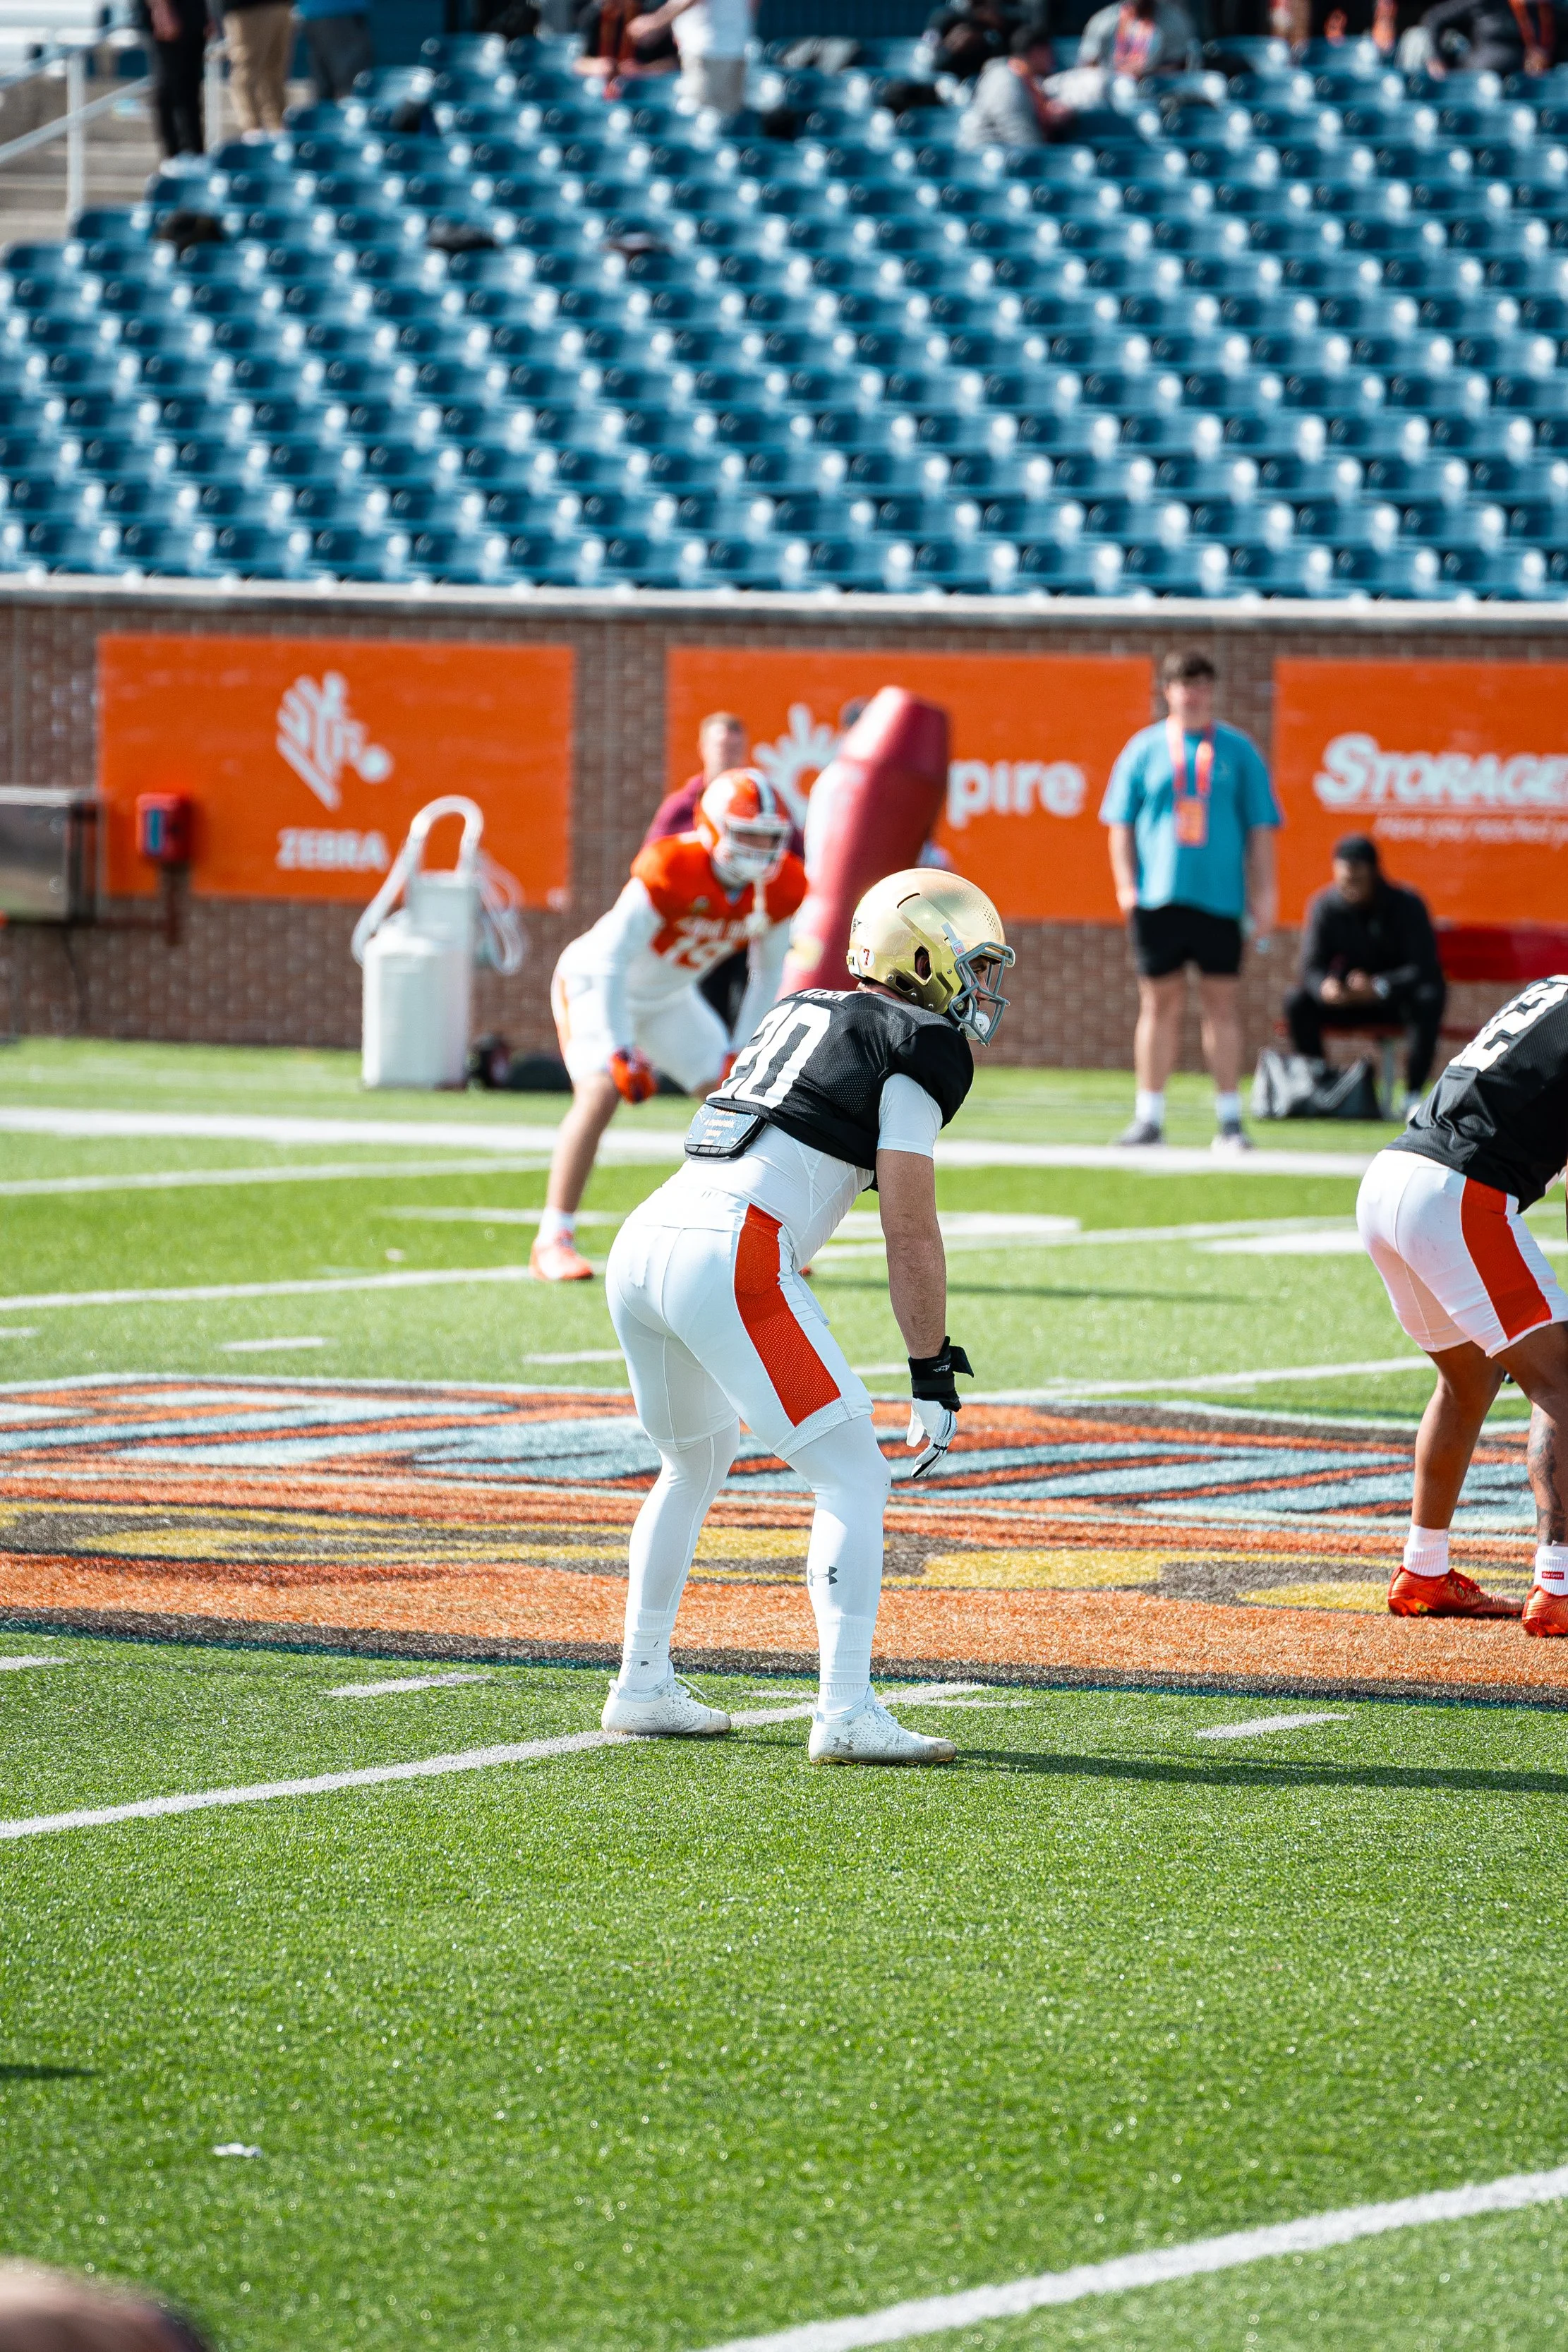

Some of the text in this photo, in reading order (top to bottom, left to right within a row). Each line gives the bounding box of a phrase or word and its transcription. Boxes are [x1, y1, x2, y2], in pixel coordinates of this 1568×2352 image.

[946, 760, 1087, 831] pire
[276, 827, 389, 873] ZEBRA
[706, 1001, 831, 1109] 20
